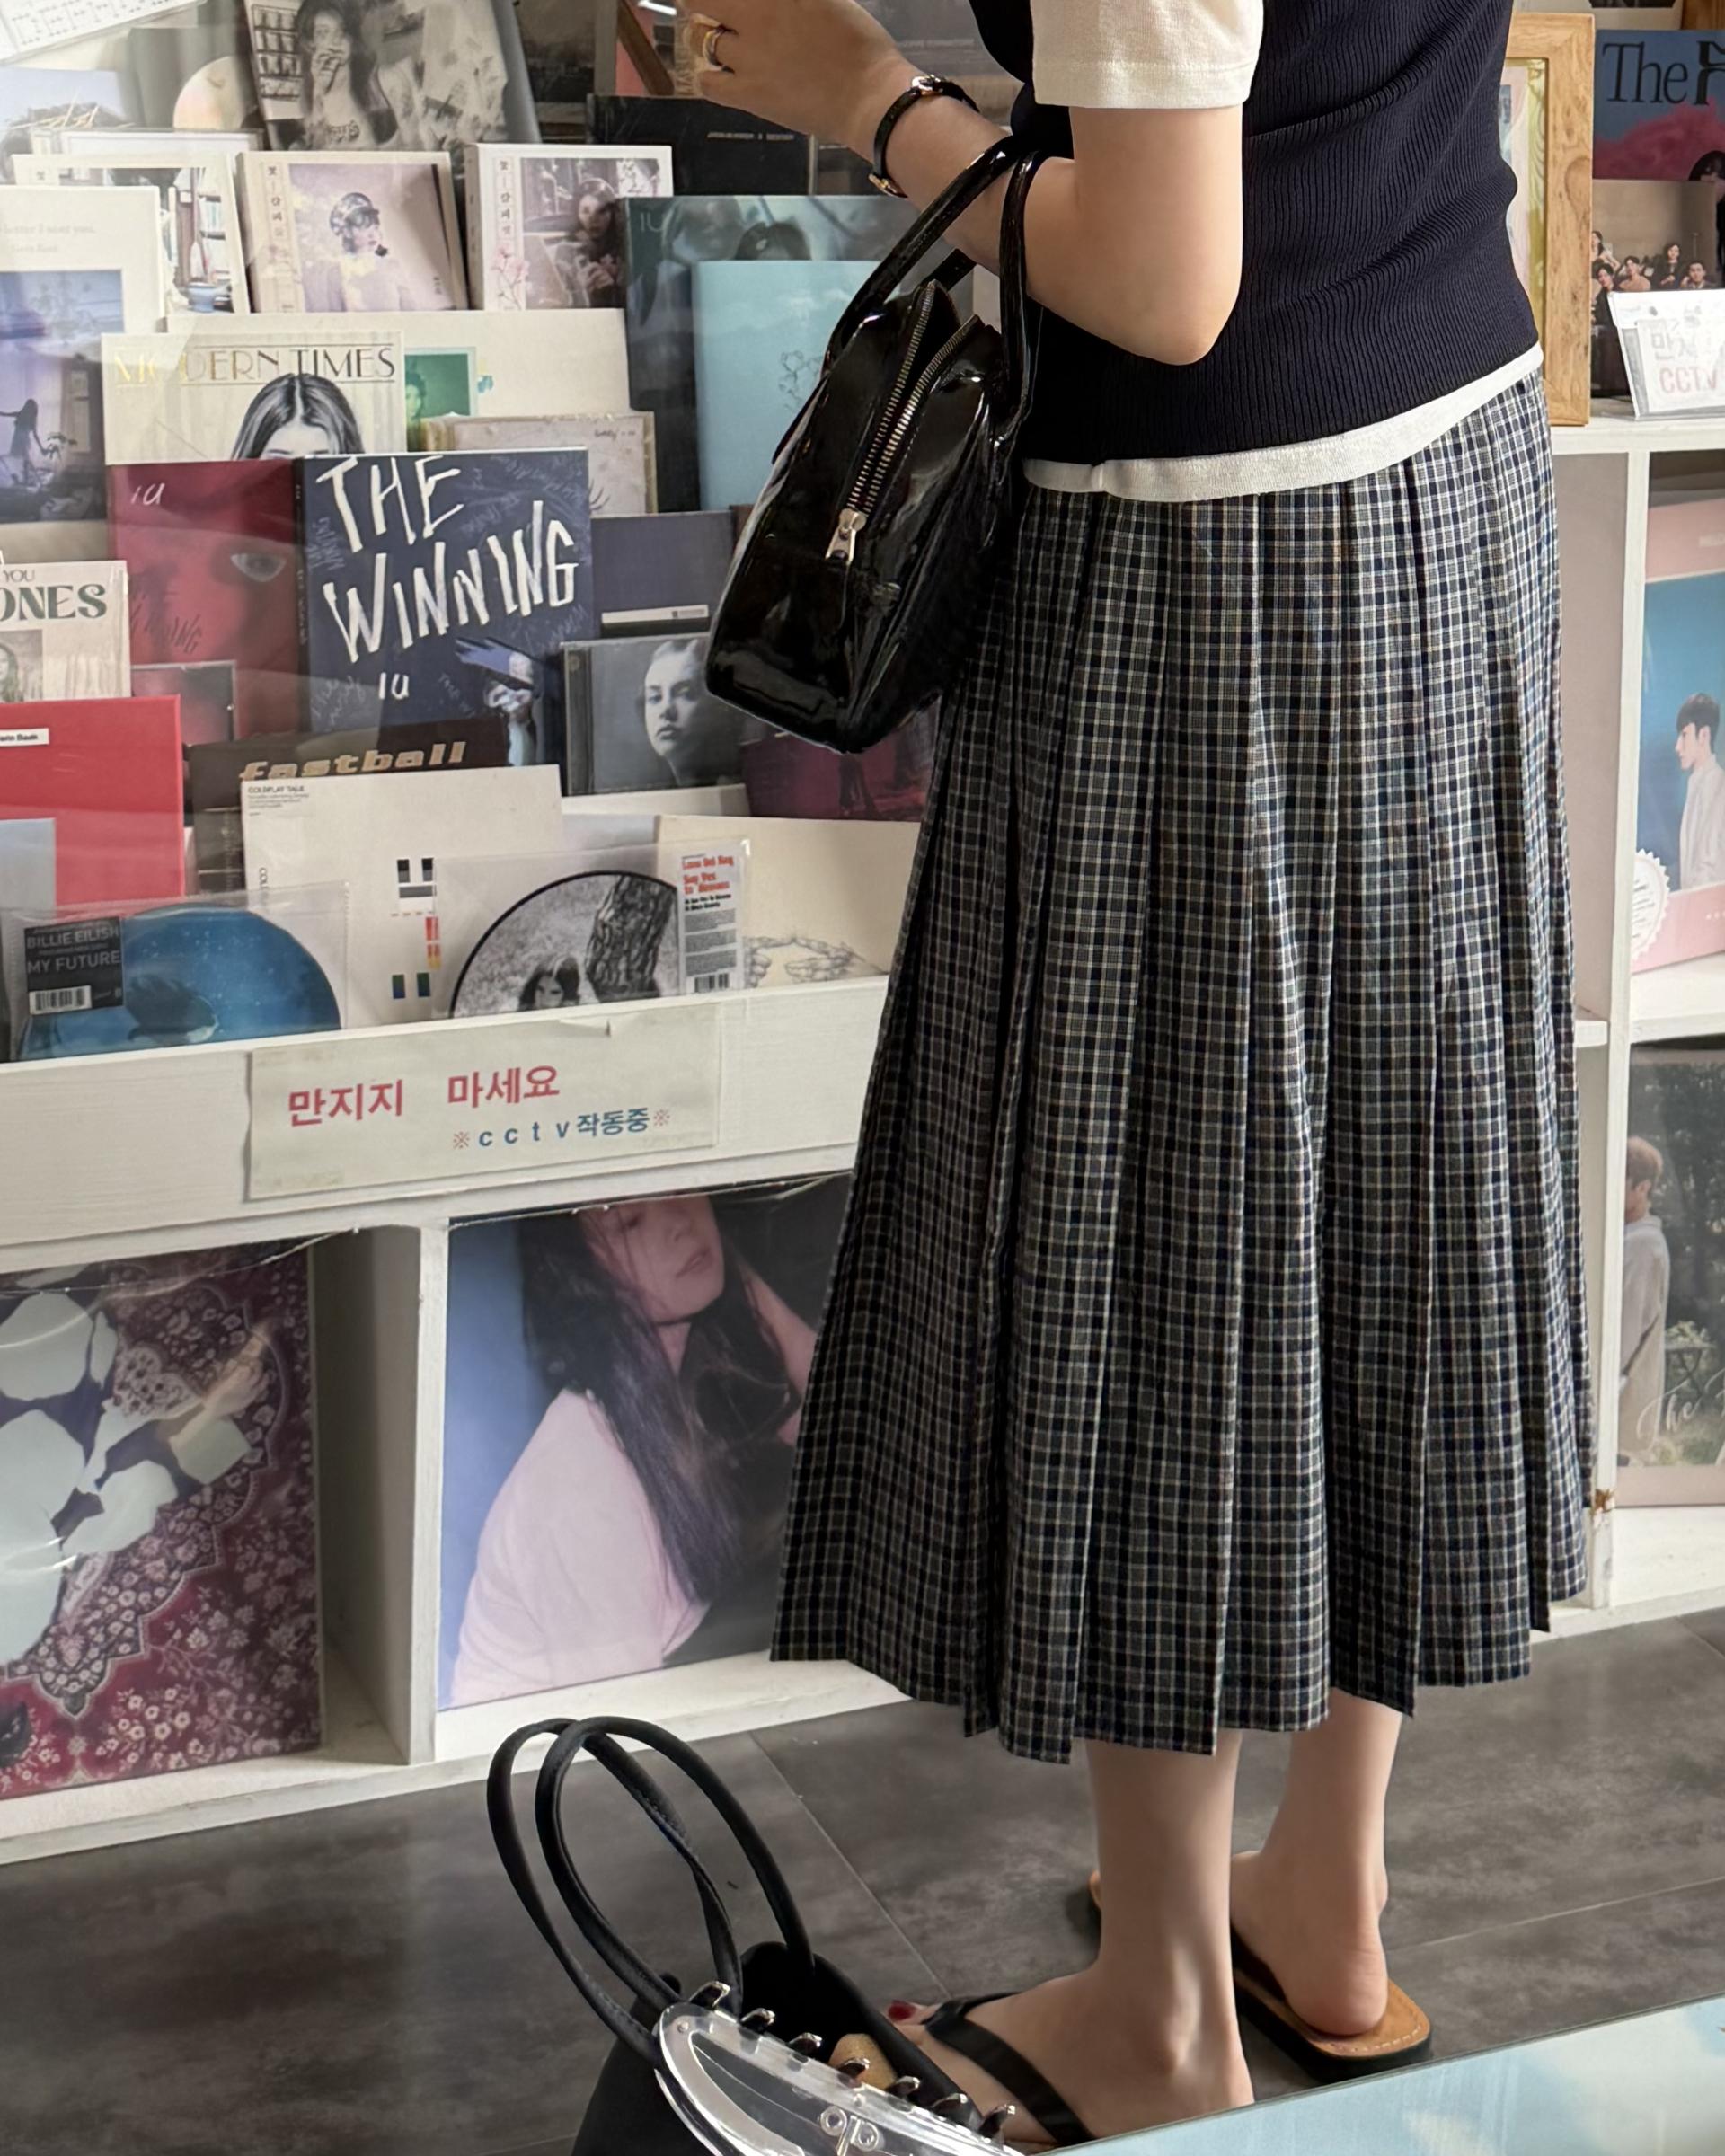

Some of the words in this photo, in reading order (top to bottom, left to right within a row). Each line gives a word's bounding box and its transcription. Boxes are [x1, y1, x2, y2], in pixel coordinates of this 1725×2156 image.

[1602, 41, 1689, 104] The
[289, 347, 395, 378] TIMES
[315, 455, 464, 552] THE
[323, 500, 579, 663] WINNING
[239, 741, 466, 781] fastball
[27, 932, 72, 950] BILLIE
[75, 926, 119, 943] EILISH
[27, 959, 50, 975] MY
[55, 950, 121, 971] FUTURE
[288, 1080, 402, 1127] 만지지
[447, 1065, 561, 1108] 마세요
